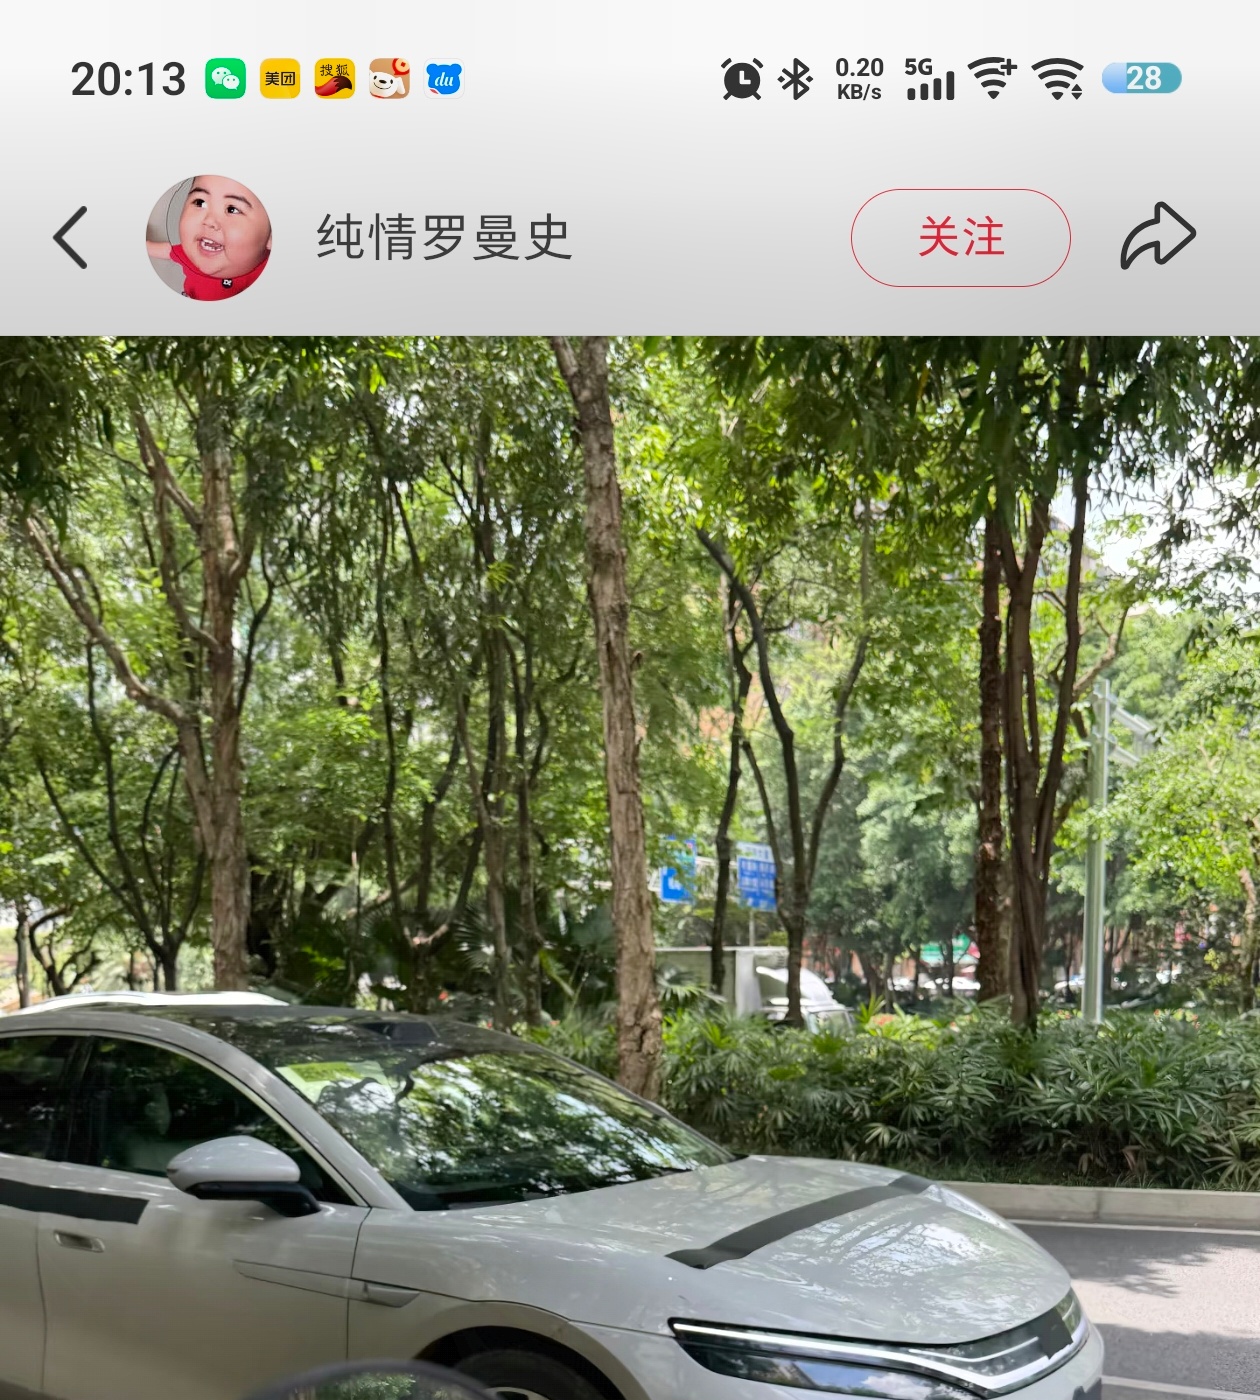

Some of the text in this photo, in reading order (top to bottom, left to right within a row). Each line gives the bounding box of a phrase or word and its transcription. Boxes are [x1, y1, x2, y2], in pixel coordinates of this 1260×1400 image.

[319, 63, 350, 77] 搜狐
[835, 57, 885, 77] 0.20
[904, 57, 933, 76] 5G
[71, 61, 186, 97] 20:13
[264, 70, 297, 88] 美团
[434, 71, 455, 87] du
[1126, 65, 1163, 91] 28
[837, 83, 882, 101] KB/s
[316, 212, 573, 261] 纯情罗曼史
[918, 215, 1005, 257] 关注
